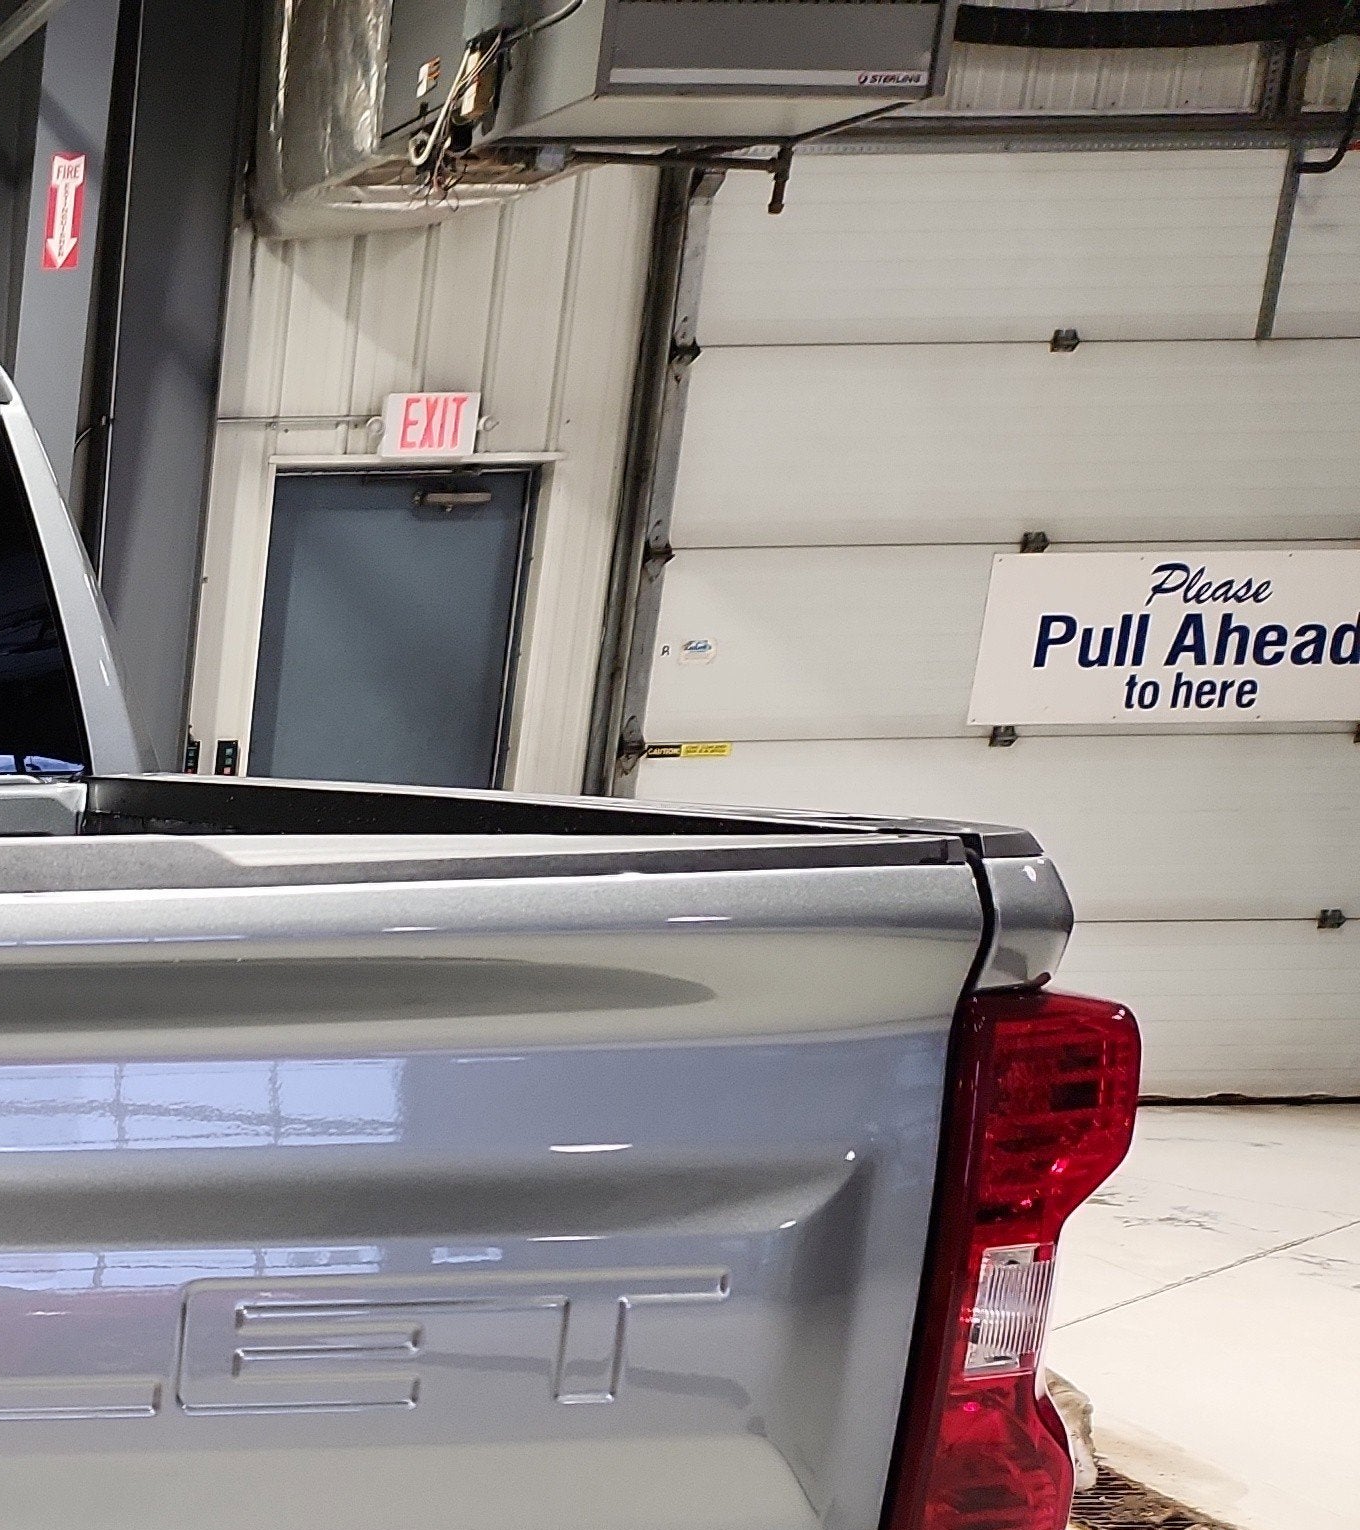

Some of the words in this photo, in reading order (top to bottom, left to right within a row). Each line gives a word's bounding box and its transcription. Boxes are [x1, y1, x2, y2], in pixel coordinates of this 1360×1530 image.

[57, 165, 80, 180] FIRE
[400, 396, 468, 449] EXIT
[1145, 562, 1273, 606] Please
[1033, 613, 1152, 668] Pull
[1163, 612, 1360, 666] Ahead
[1124, 673, 1160, 710] to
[1170, 672, 1258, 710] here
